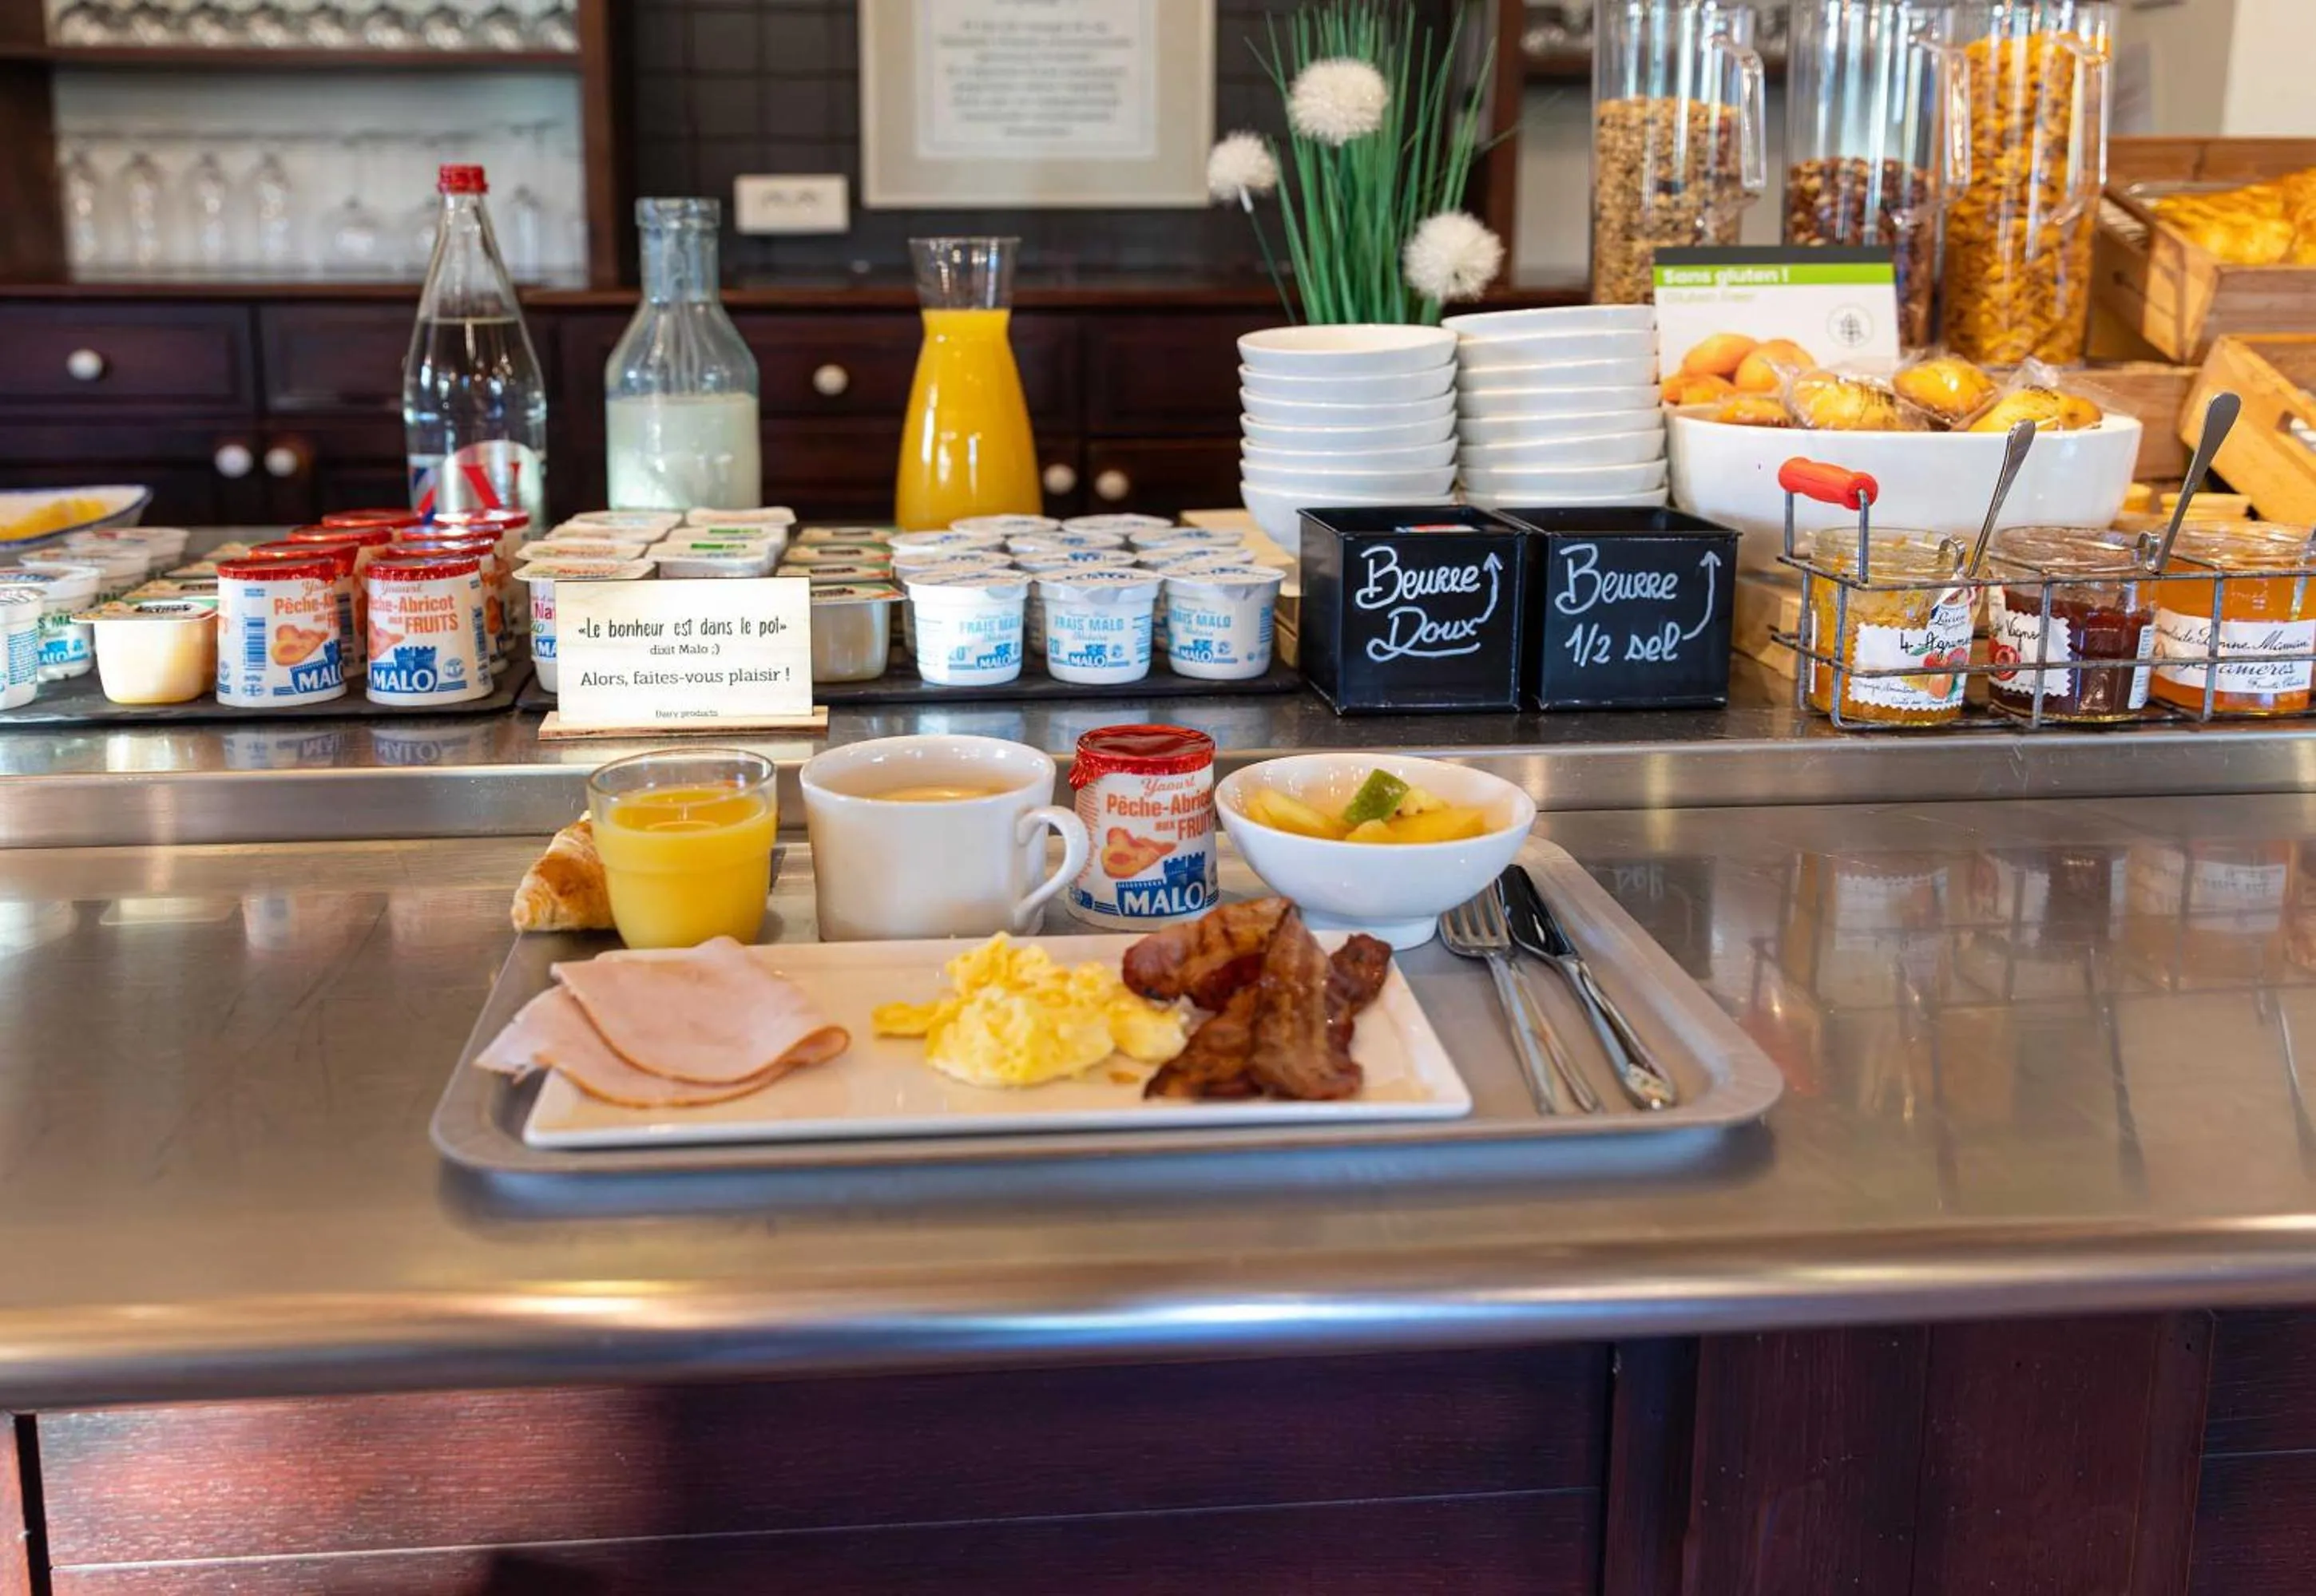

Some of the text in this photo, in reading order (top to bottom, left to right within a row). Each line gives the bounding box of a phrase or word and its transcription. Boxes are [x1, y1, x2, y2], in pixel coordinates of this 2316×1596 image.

[1663, 269, 1711, 284] Sans
[1715, 267, 1779, 288] gluten
[1355, 545, 1481, 609] Beurre
[1554, 543, 1678, 616] Beurre
[404, 613, 458, 635] FRUITS
[609, 618, 664, 638] bonheur
[674, 618, 692, 637] est
[700, 617, 733, 636] dans
[740, 616, 752, 636] le
[1366, 605, 1480, 662] Doux
[649, 644, 675, 655] dixit
[678, 644, 708, 655] Malo
[1564, 620, 1680, 667] 1/2 sel
[1070, 654, 1105, 667] MALO
[372, 668, 436, 692] MALO
[580, 671, 629, 687] Alors,
[633, 670, 724, 686] faites-vous
[728, 667, 780, 686] plaisir
[680, 708, 719, 719] products
[1124, 881, 1205, 916] MALO
